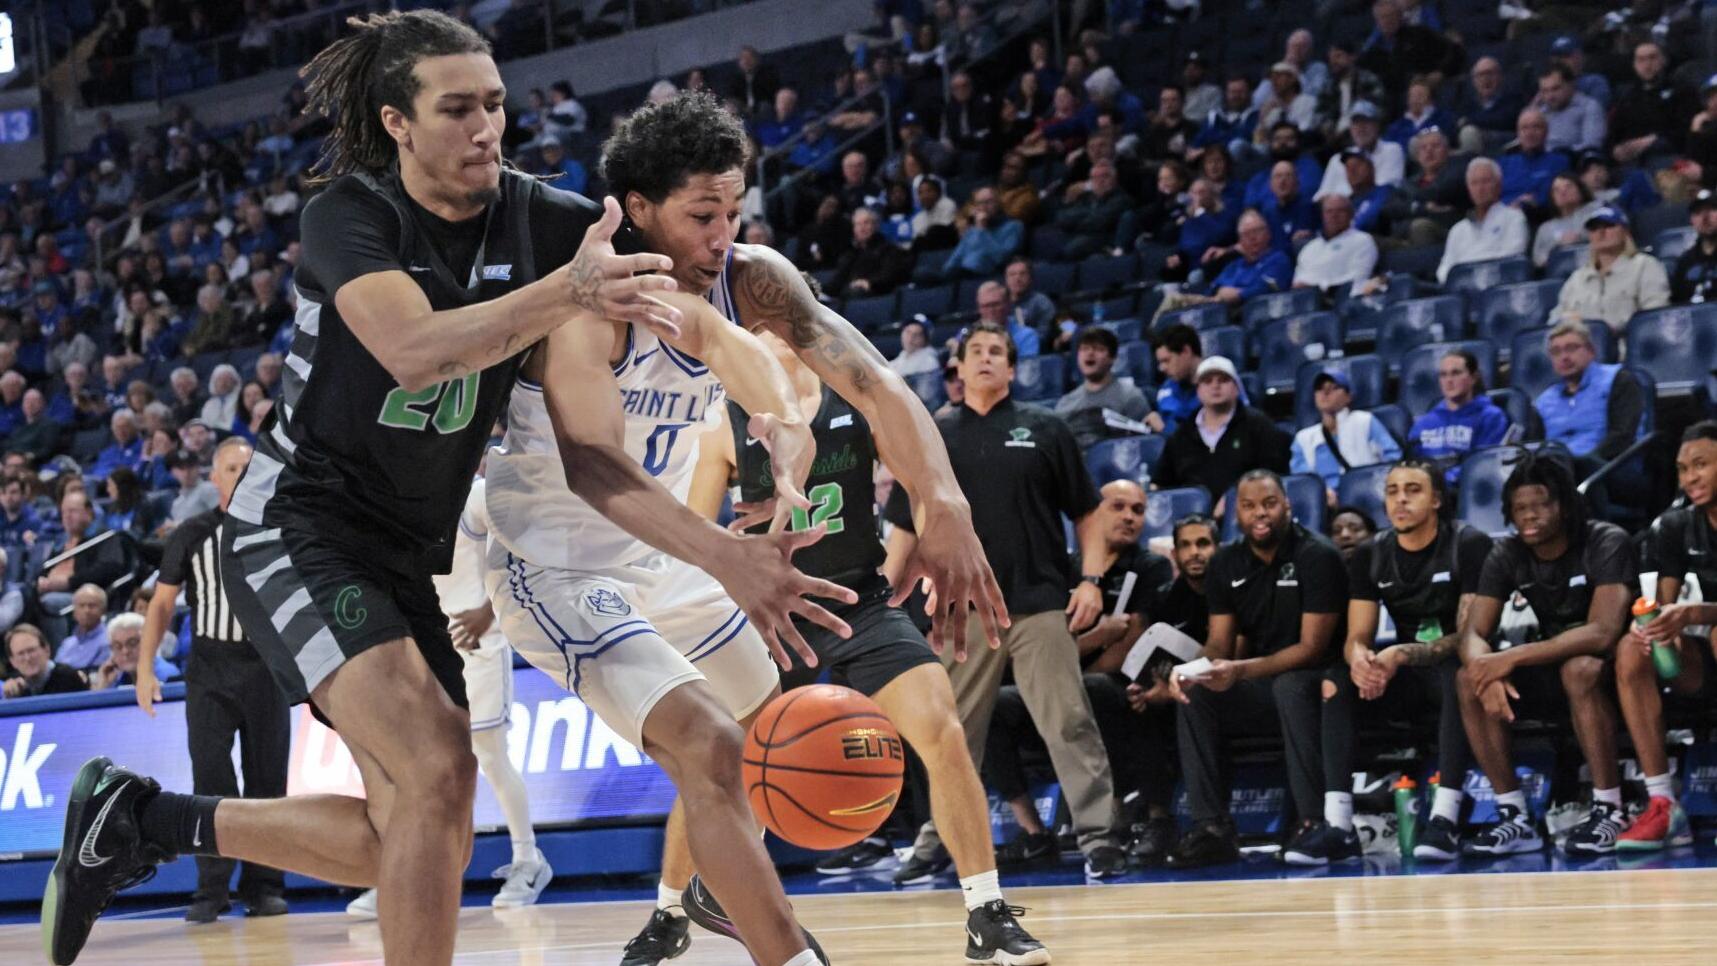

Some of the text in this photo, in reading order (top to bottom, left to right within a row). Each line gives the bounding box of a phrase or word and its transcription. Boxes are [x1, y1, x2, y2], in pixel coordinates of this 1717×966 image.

[378, 371, 480, 434] 20
[620, 388, 682, 419] AINT
[643, 423, 690, 477] 0
[335, 585, 367, 629] C
[842, 737, 902, 761] ELITE
